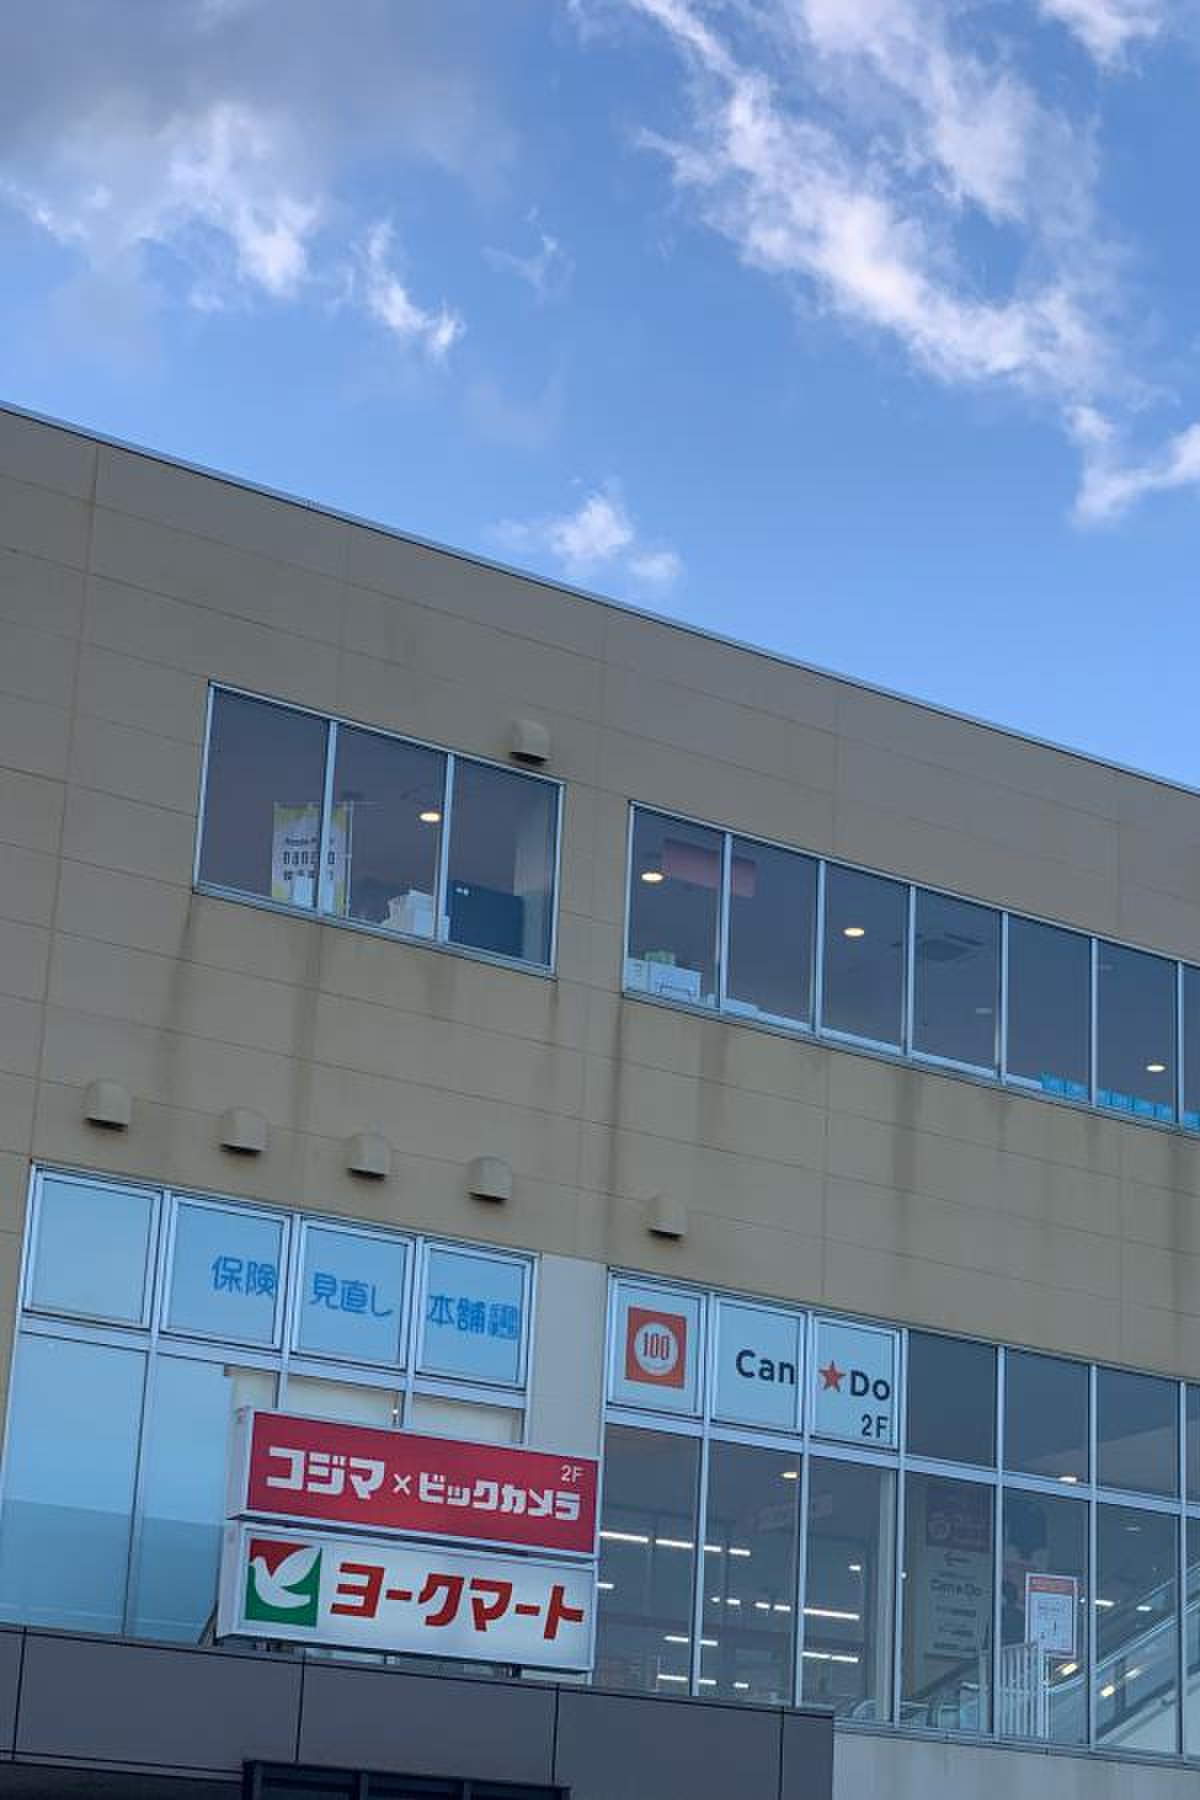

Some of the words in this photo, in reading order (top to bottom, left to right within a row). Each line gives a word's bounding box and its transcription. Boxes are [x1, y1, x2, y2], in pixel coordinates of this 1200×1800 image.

[643, 1331, 671, 1360] 100
[735, 1349, 796, 1386] Can
[849, 1371, 890, 1401] Do
[861, 1414, 889, 1438] 2F
[561, 1464, 584, 1484] 2F
[330, 1562, 584, 1640] ヨークマート
